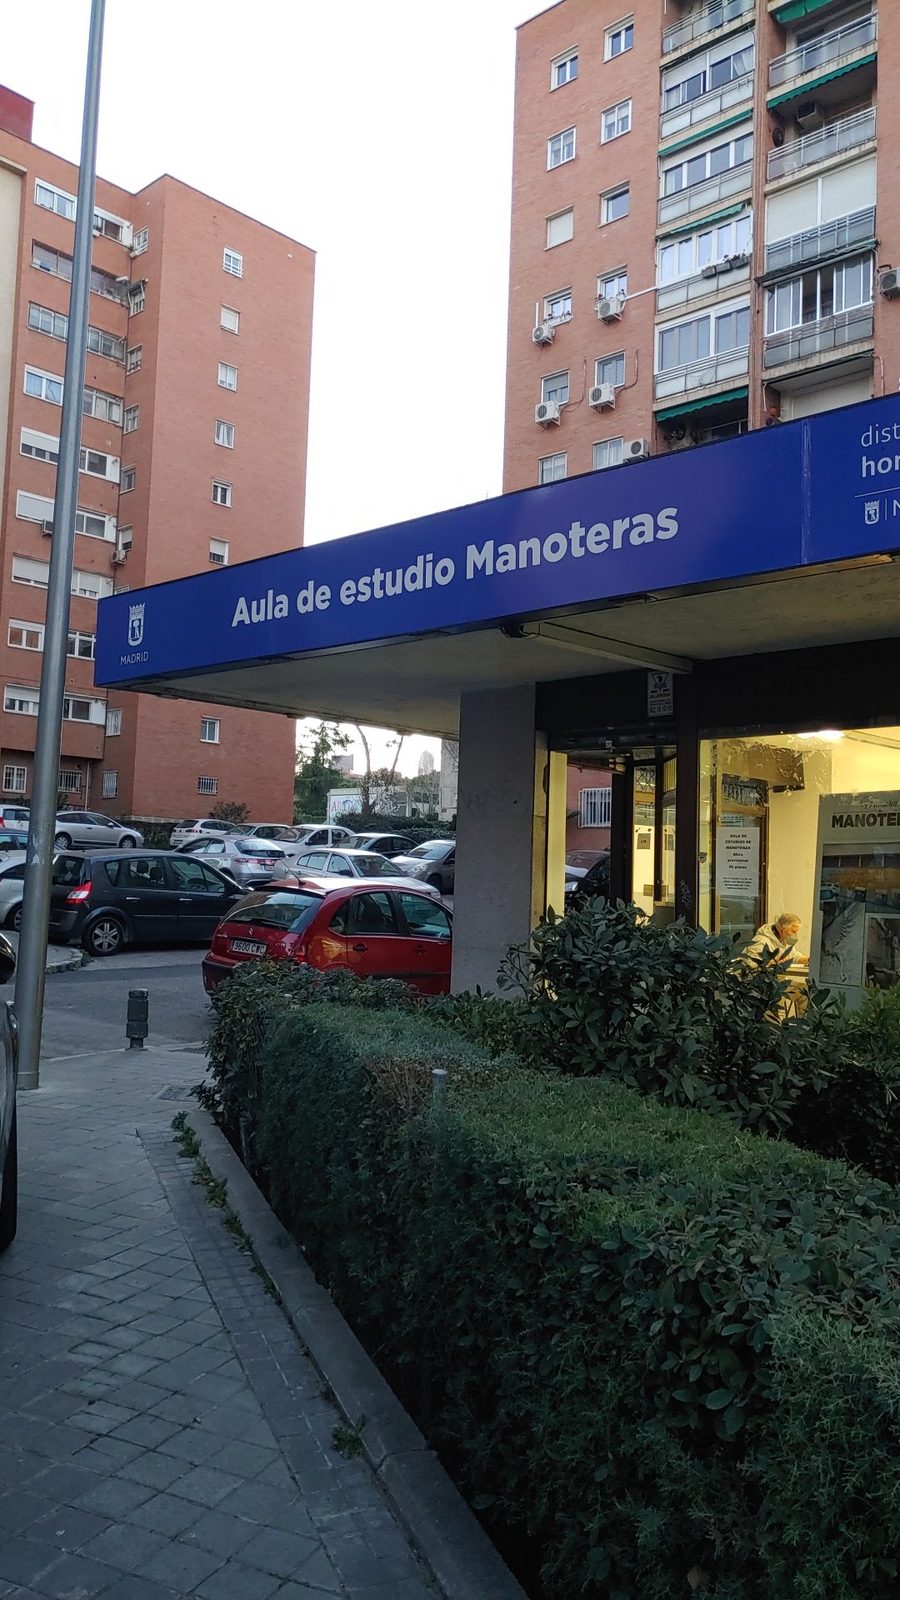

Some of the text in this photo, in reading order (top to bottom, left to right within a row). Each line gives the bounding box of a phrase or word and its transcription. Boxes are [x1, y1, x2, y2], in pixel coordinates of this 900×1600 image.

[231, 507, 679, 628] Aula de estudio Manoteras
[120, 651, 149, 667] MADRID
[234, 941, 251, 952] 9600
